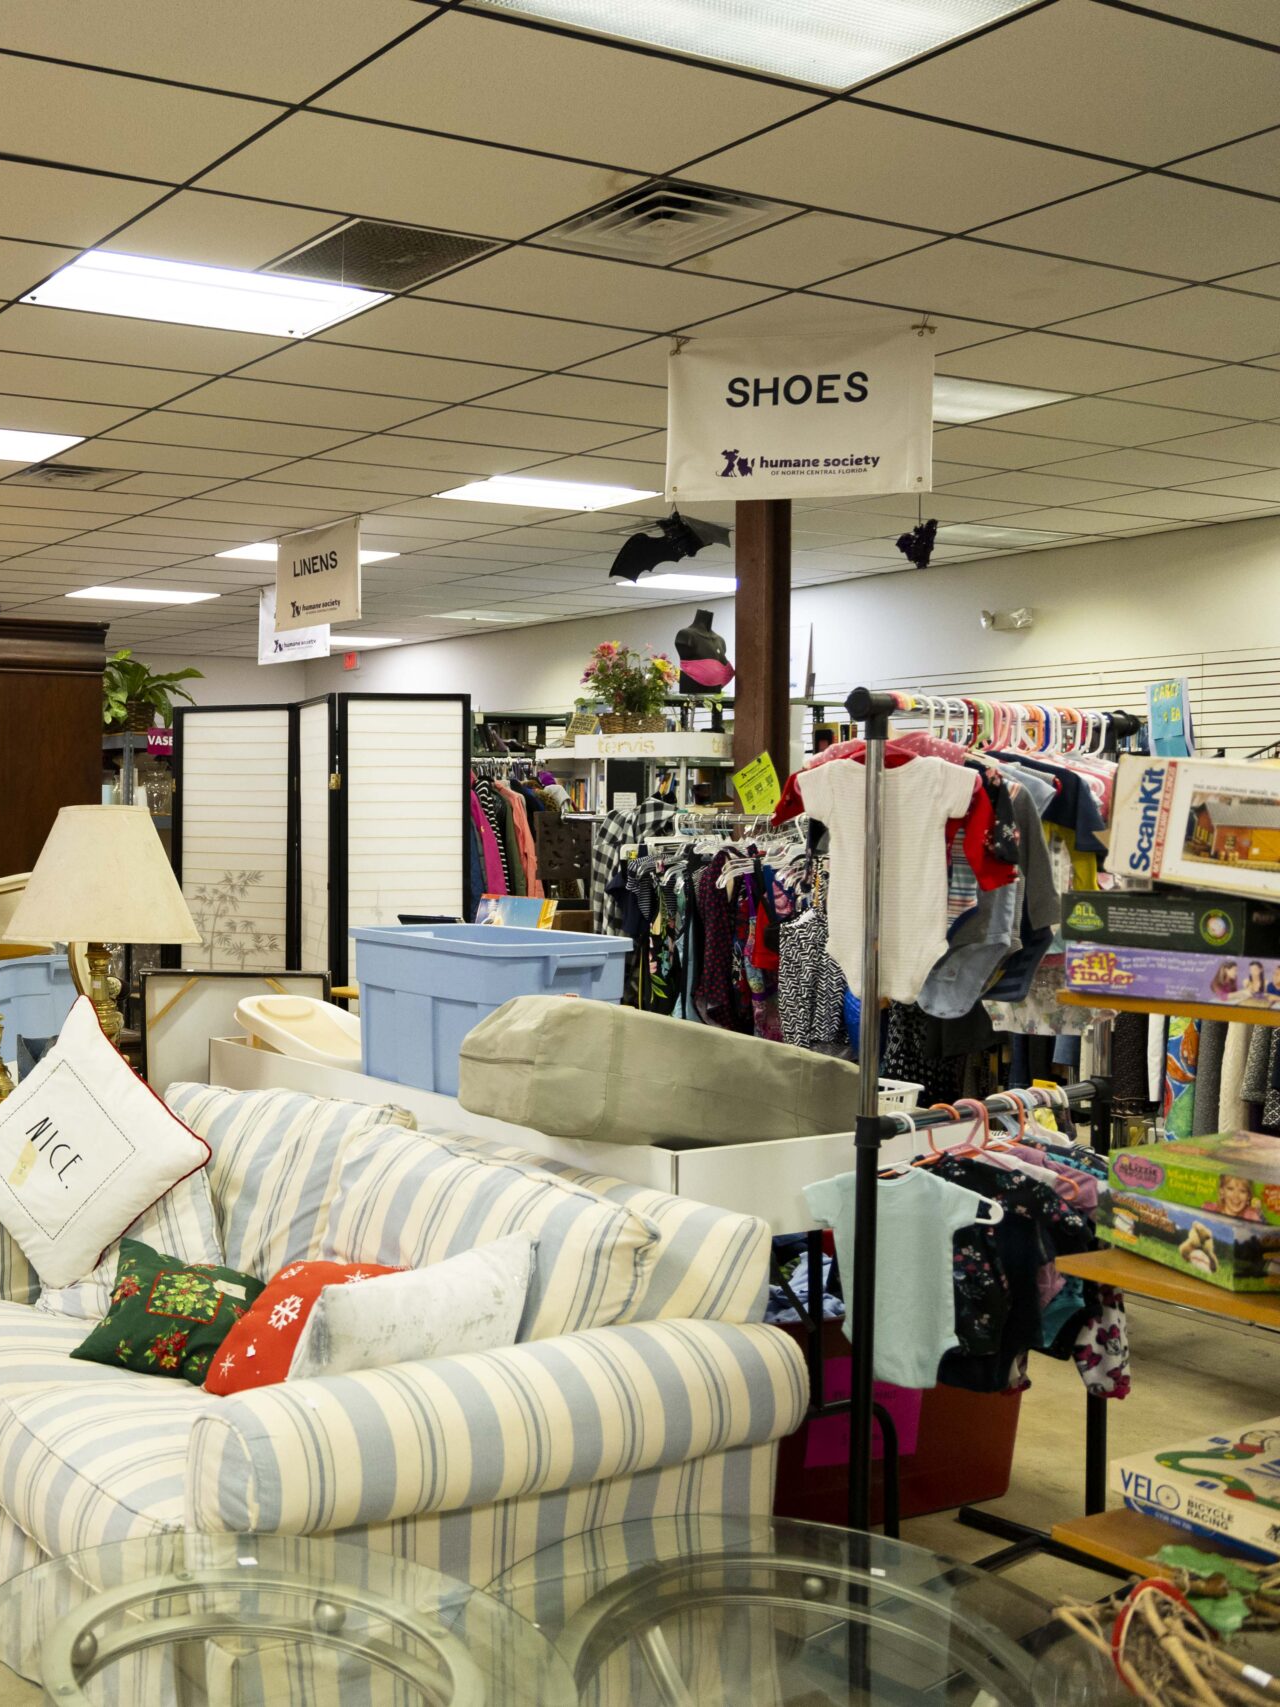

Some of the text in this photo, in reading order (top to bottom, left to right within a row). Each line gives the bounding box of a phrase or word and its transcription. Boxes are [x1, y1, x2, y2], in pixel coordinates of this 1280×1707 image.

[725, 371, 869, 408] SHOES
[760, 453, 881, 469] humane society
[806, 468, 837, 476] CENTRAL
[838, 467, 868, 475] FLORIDA
[292, 550, 338, 578] LINENS
[1129, 766, 1165, 872] ScanKit
[1075, 904, 1095, 916] ALL
[1120, 1468, 1181, 1511] VELO
[1185, 1508, 1230, 1531] RACING
[1186, 1499, 1235, 1523] BICYCLE
